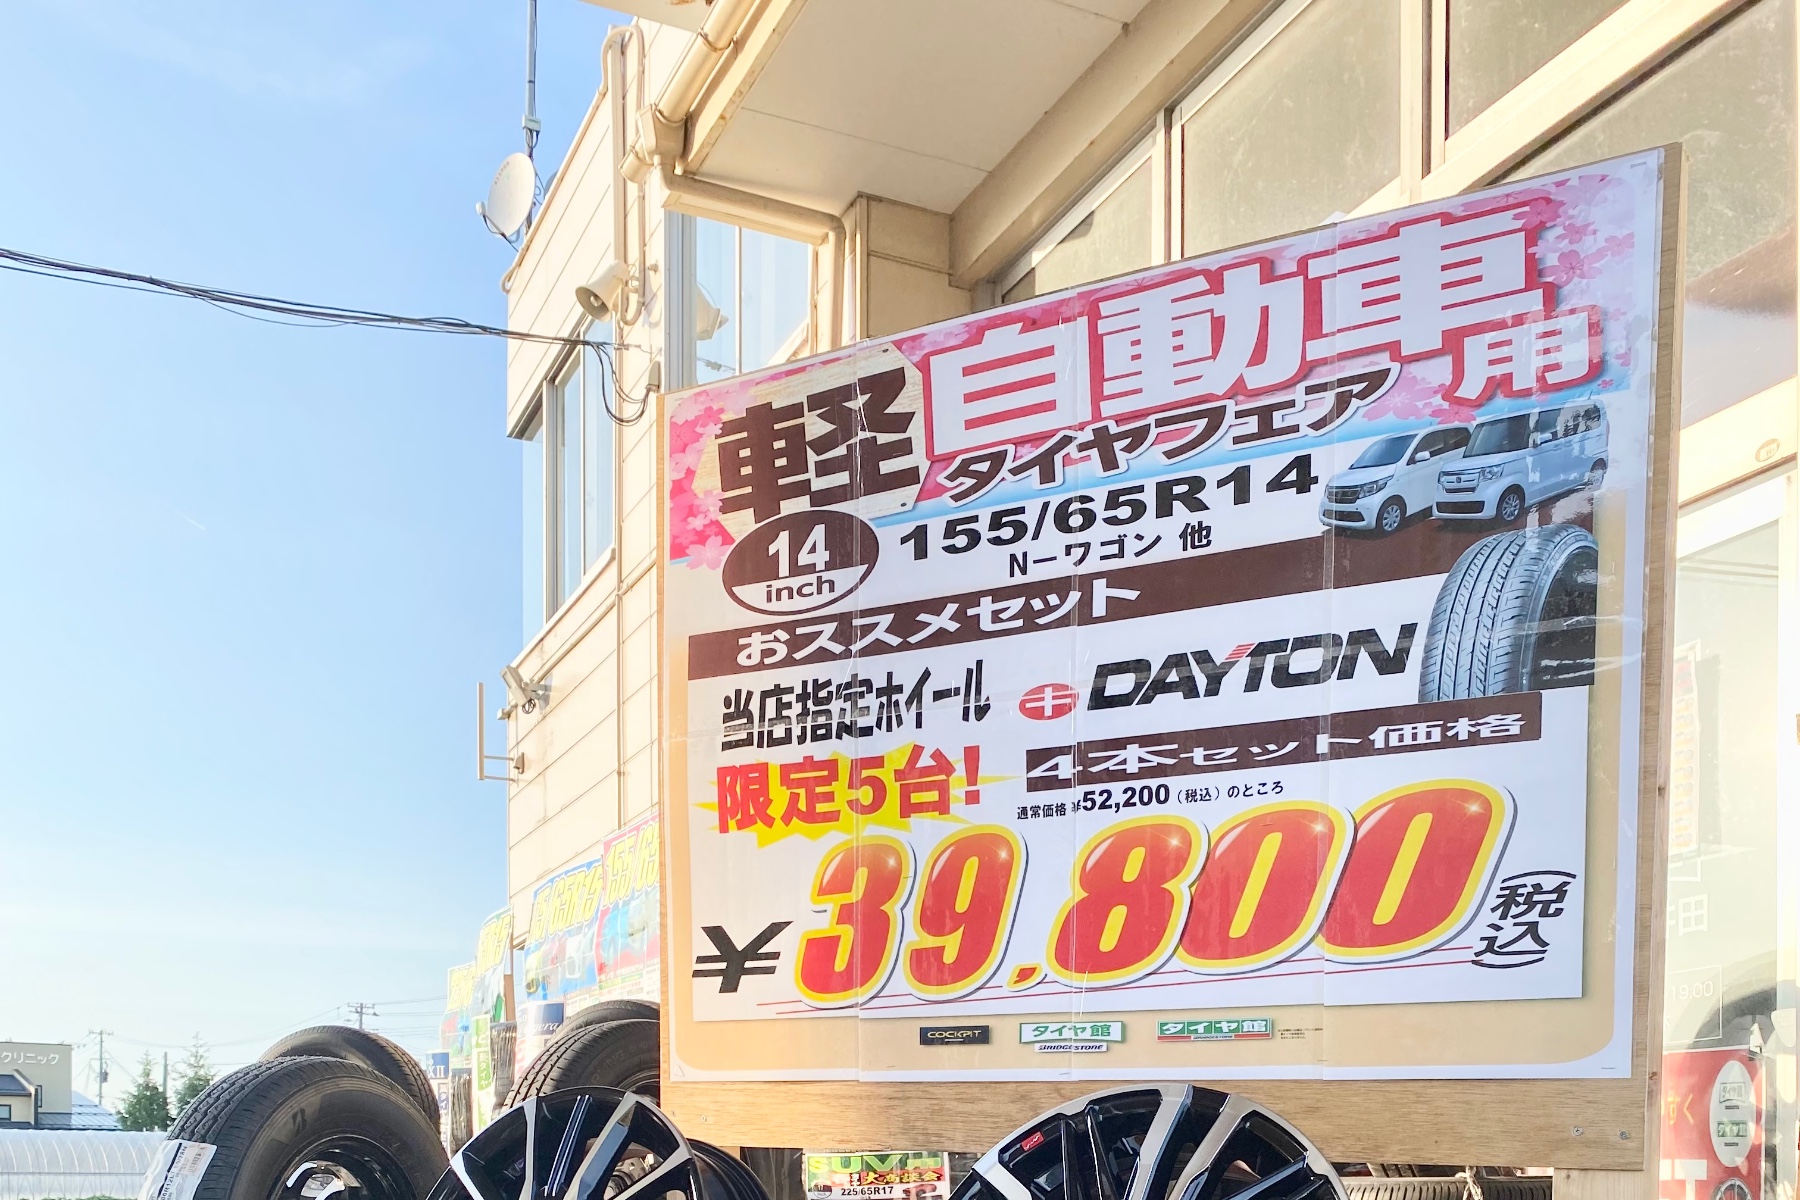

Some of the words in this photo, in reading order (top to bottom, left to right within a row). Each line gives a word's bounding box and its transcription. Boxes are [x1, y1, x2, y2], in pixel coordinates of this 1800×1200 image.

[943, 366, 1394, 503] タイヤフェア
[899, 455, 1320, 561] 155/65R14
[1178, 520, 1214, 552] 他
[767, 534, 831, 578] 14
[765, 575, 836, 604] inch
[736, 578, 1142, 667] おススメセット
[1087, 622, 1419, 712] DAYTON
[721, 659, 991, 752] 当店指定ホイール
[1027, 714, 1527, 781] 4本セット価格
[716, 744, 982, 835] 限定5台!
[1016, 801, 1067, 820] 通常価格
[927, 1029, 983, 1039] COCKPIT
[1031, 1023, 1113, 1038] タイヤ館
[1161, 1020, 1267, 1035] タイヤ館
[1, 1051, 60, 1065] クリニック
[1038, 1043, 1104, 1051] BRIDGESTONE
[841, 1185, 894, 1196] 225/65R17
